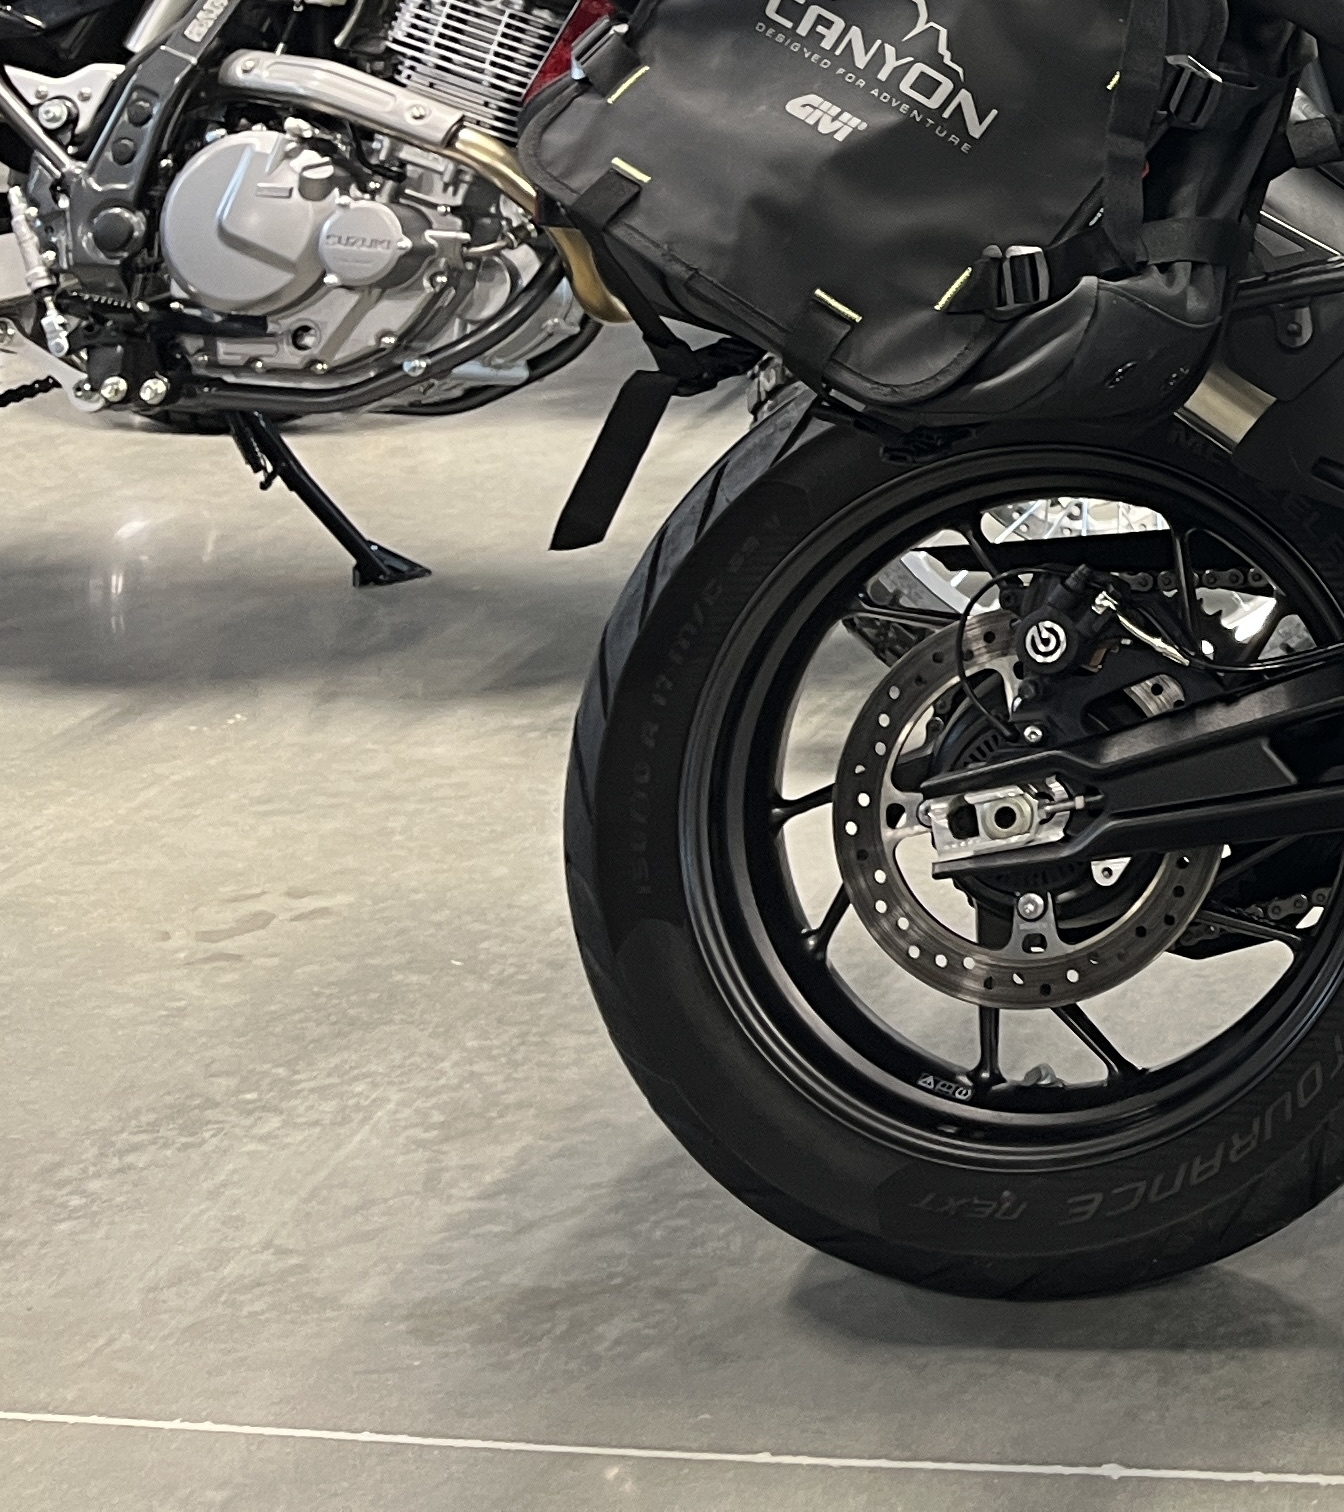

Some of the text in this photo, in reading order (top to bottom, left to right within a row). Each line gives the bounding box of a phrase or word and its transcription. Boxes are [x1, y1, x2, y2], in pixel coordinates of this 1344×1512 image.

[785, 93, 868, 142] GIVI
[835, 67, 866, 89] FOR
[869, 88, 973, 154] ADVENTURE
[325, 234, 391, 249] SUZUKI
